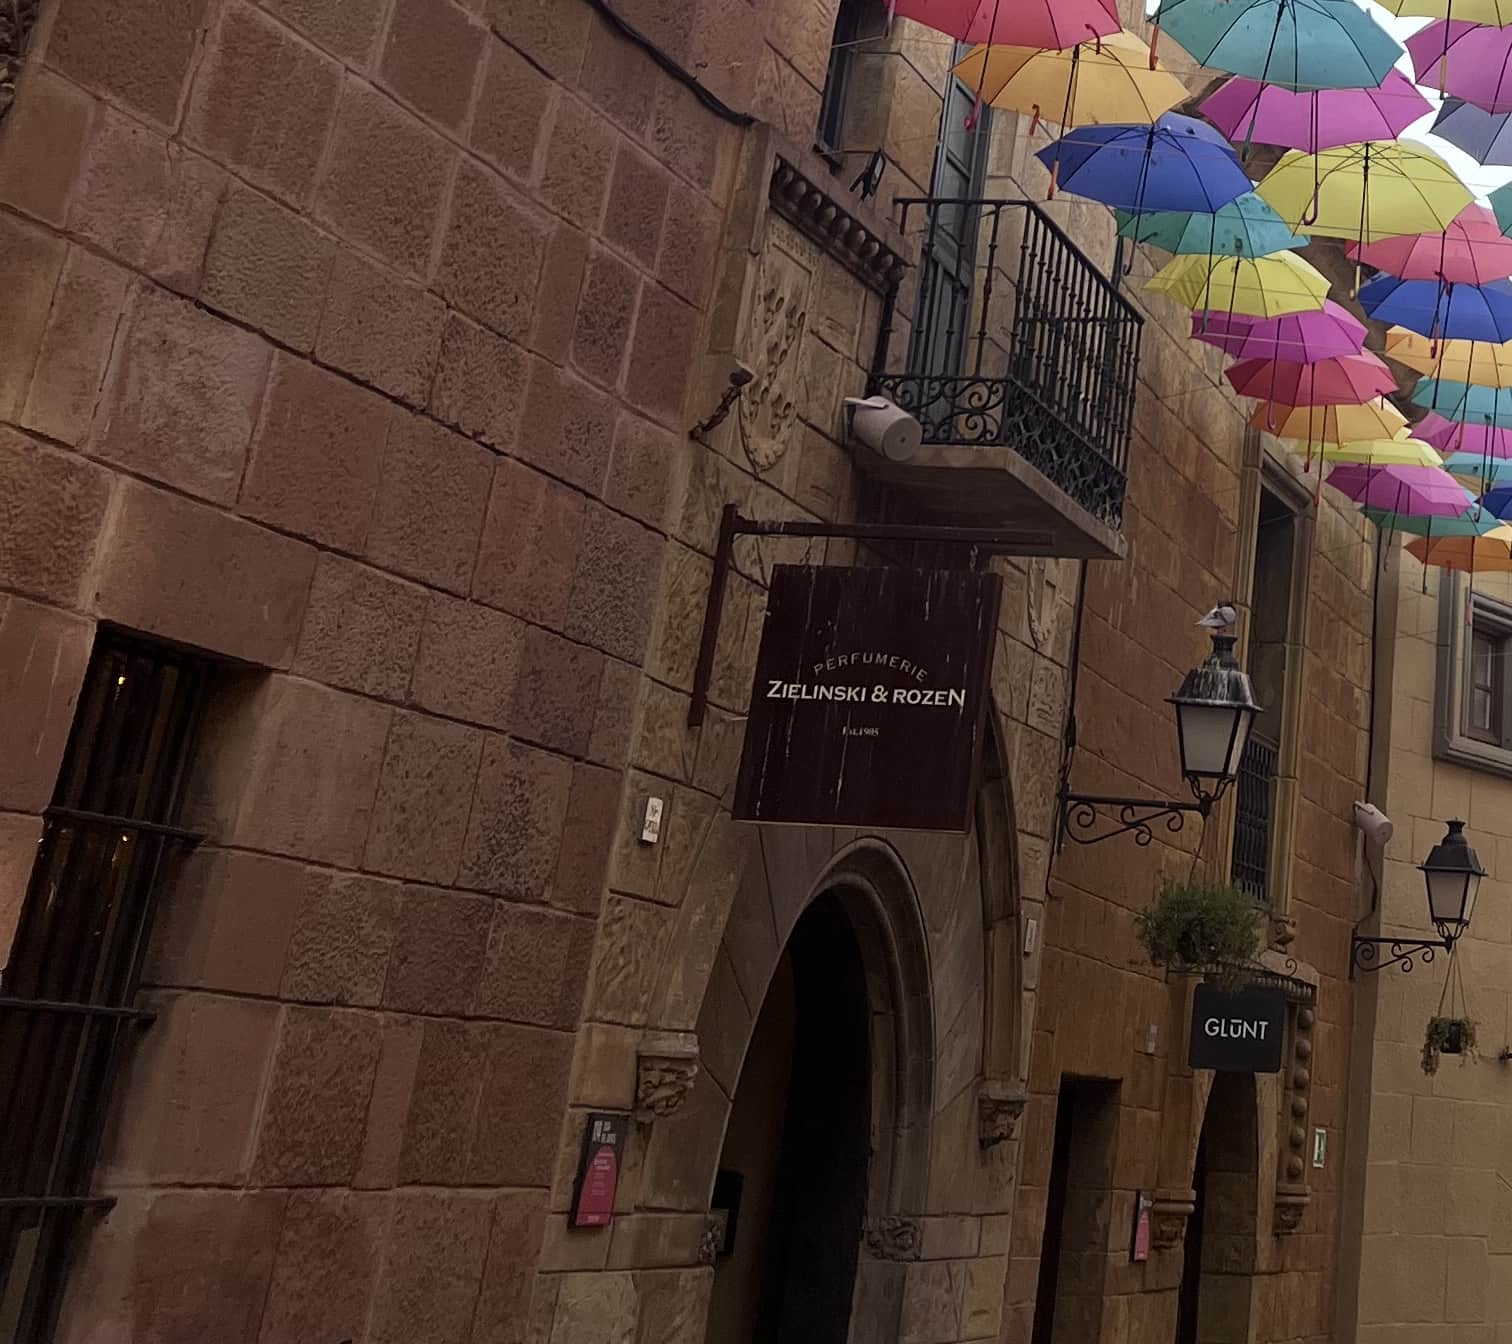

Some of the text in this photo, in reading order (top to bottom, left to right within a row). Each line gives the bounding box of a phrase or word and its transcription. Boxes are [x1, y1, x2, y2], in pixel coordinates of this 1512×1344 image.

[813, 652, 928, 683] PERFUMERIE
[767, 680, 966, 707] ZIELINSKI & ROZEN
